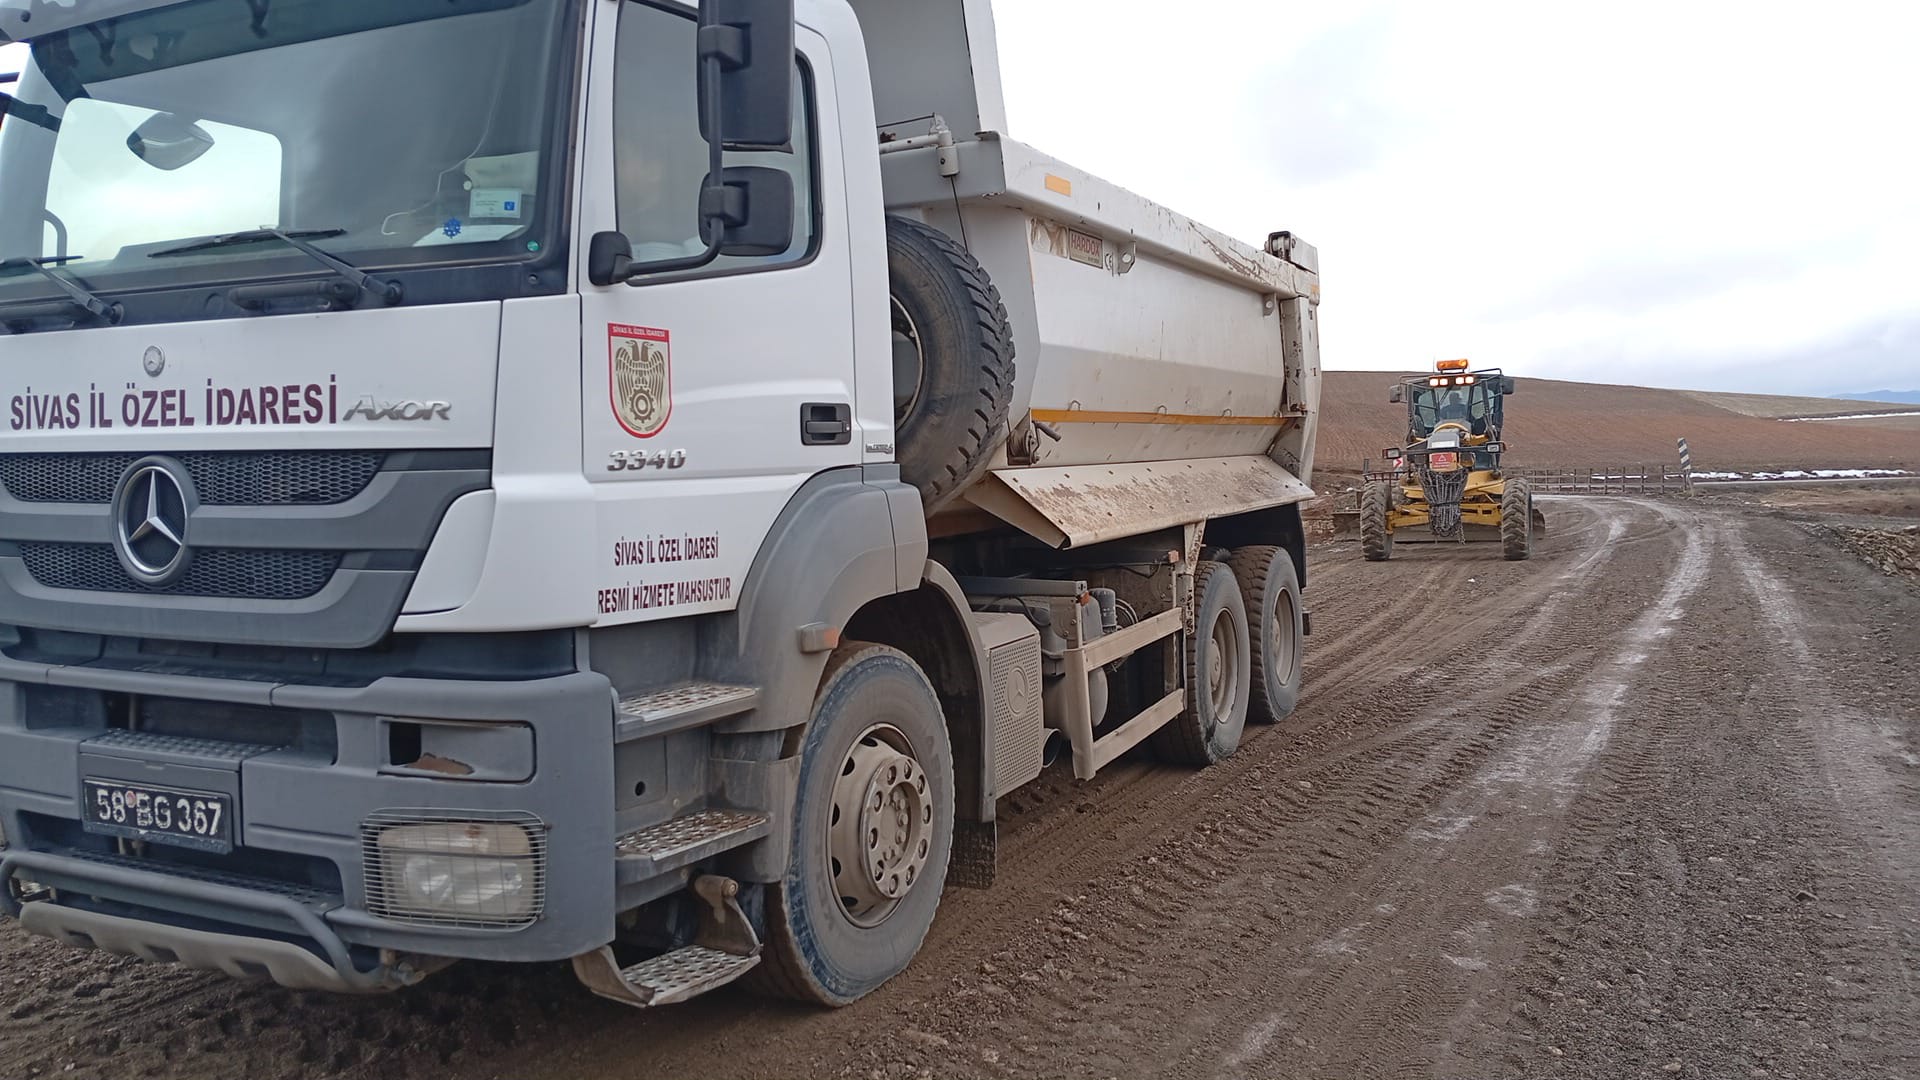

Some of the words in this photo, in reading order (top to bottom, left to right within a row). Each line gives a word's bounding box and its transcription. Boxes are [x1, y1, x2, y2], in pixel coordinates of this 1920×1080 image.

[1071, 233, 1100, 257] HARDOX
[10, 386, 80, 431] SİVAS
[90, 382, 113, 429] İL
[122, 382, 195, 428] ÖZEL
[206, 374, 337, 426] İDARESİ
[607, 448, 687, 471] 3340
[614, 535, 644, 566] SİVAS
[646, 534, 656, 564] İL
[658, 534, 682, 563] ÖZEL
[684, 530, 719, 561] İDARESİ
[598, 580, 630, 614] RESMİ
[632, 579, 675, 610] HİZMETE
[676, 576, 732, 605] MAHSUSTUR
[96, 788, 126, 823] 58
[136, 792, 171, 829] BG
[176, 798, 222, 836] 367
